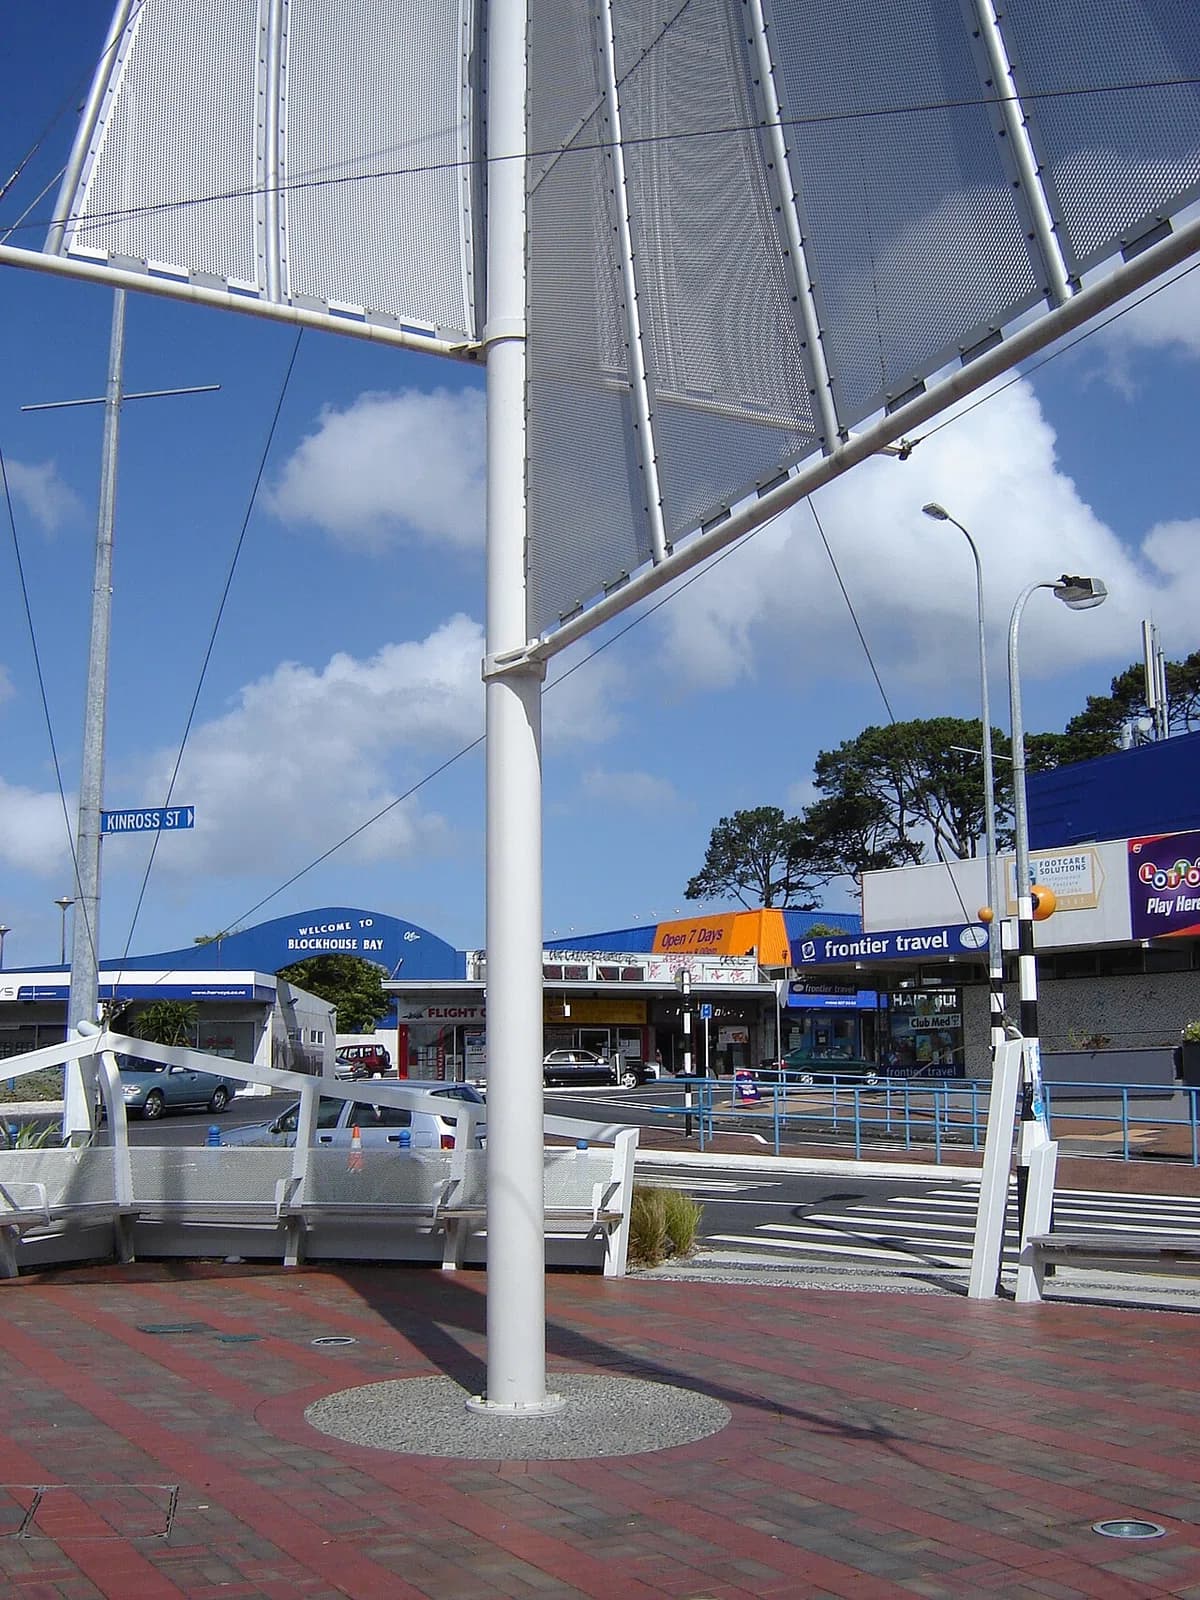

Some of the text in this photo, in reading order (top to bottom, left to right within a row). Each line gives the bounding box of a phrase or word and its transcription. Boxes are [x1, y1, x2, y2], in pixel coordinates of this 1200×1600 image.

[107, 811, 180, 830] KINROSS ST
[1040, 856, 1086, 868] FOOTCARE
[1040, 864, 1087, 875] SOLUTIONS
[1139, 859, 1200, 890] LOTTO
[1146, 895, 1200, 917] Play Here
[298, 918, 374, 936] WELCOME TO
[288, 938, 384, 951] BLOCKHOUSE BAY
[661, 927, 724, 950] Open 7 Days
[824, 937, 890, 958] frontier
[896, 930, 949, 951] travel
[805, 983, 855, 993] frontier travel
[427, 1007, 477, 1018] FLIGHT
[911, 1015, 950, 1028] Club Med
[927, 1065, 957, 1077] travel
